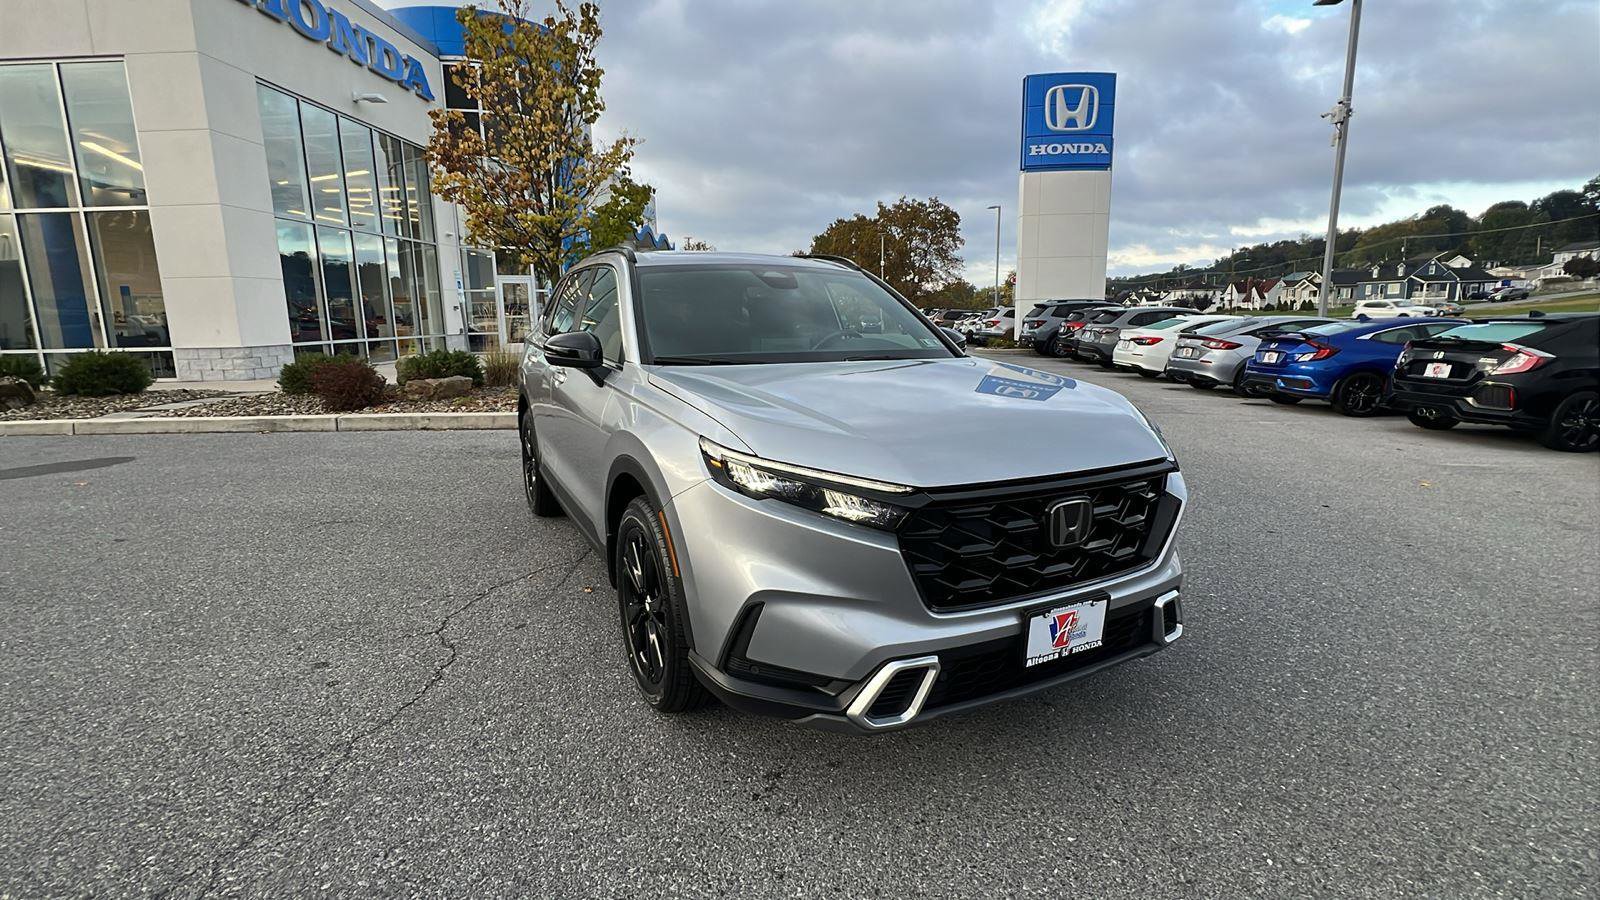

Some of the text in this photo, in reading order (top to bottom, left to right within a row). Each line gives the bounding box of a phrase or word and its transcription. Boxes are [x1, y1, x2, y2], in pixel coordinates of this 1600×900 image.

[236, 0, 435, 101] ONDA
[1029, 143, 1109, 155] HONDA
[1026, 652, 1059, 668] Altoona
[1072, 640, 1103, 654] HONDA
